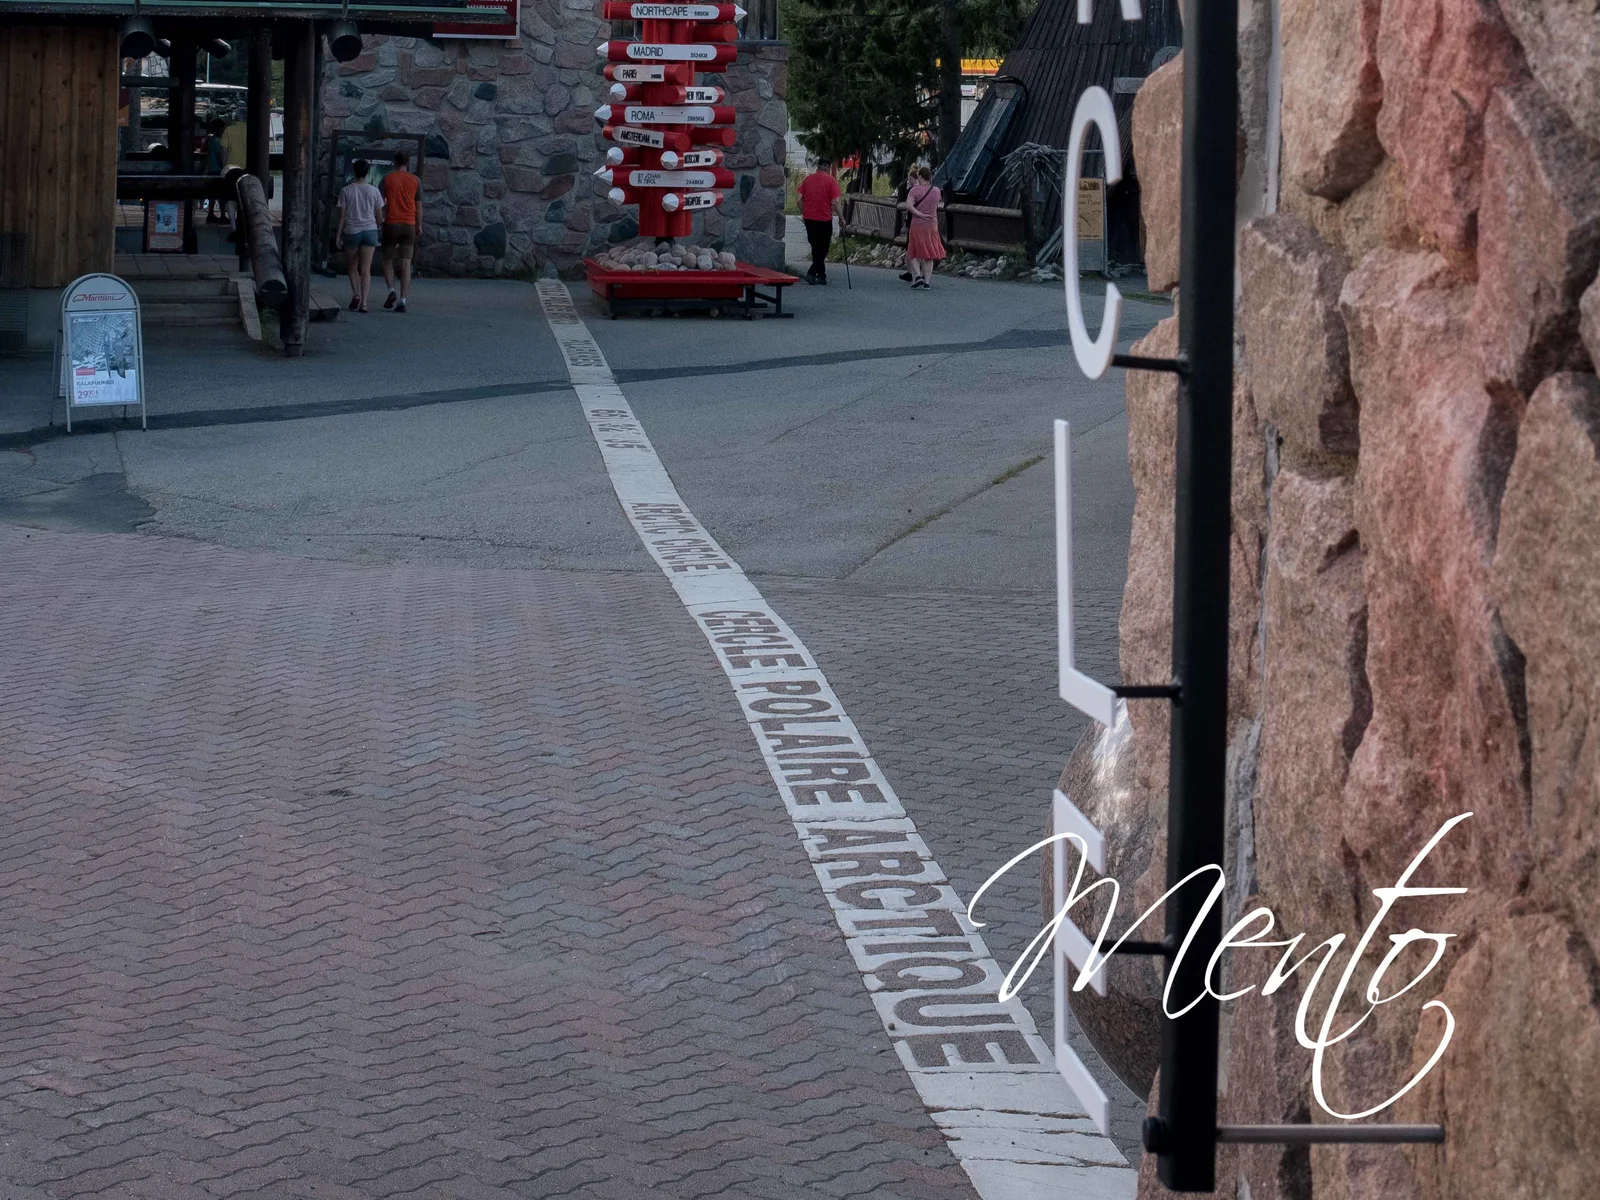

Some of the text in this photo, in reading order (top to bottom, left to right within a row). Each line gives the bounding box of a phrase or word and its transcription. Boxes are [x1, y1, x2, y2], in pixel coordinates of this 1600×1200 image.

[636, 6, 688, 16] NORTHCAPE
[633, 46, 664, 57] MADRID
[631, 110, 655, 121] ROMA
[621, 130, 651, 142] AMSTERDAM
[631, 502, 733, 573] ARCTIC CIRCLE
[697, 609, 1042, 1068] CERCLE POLAIRE ARCTIQUE
